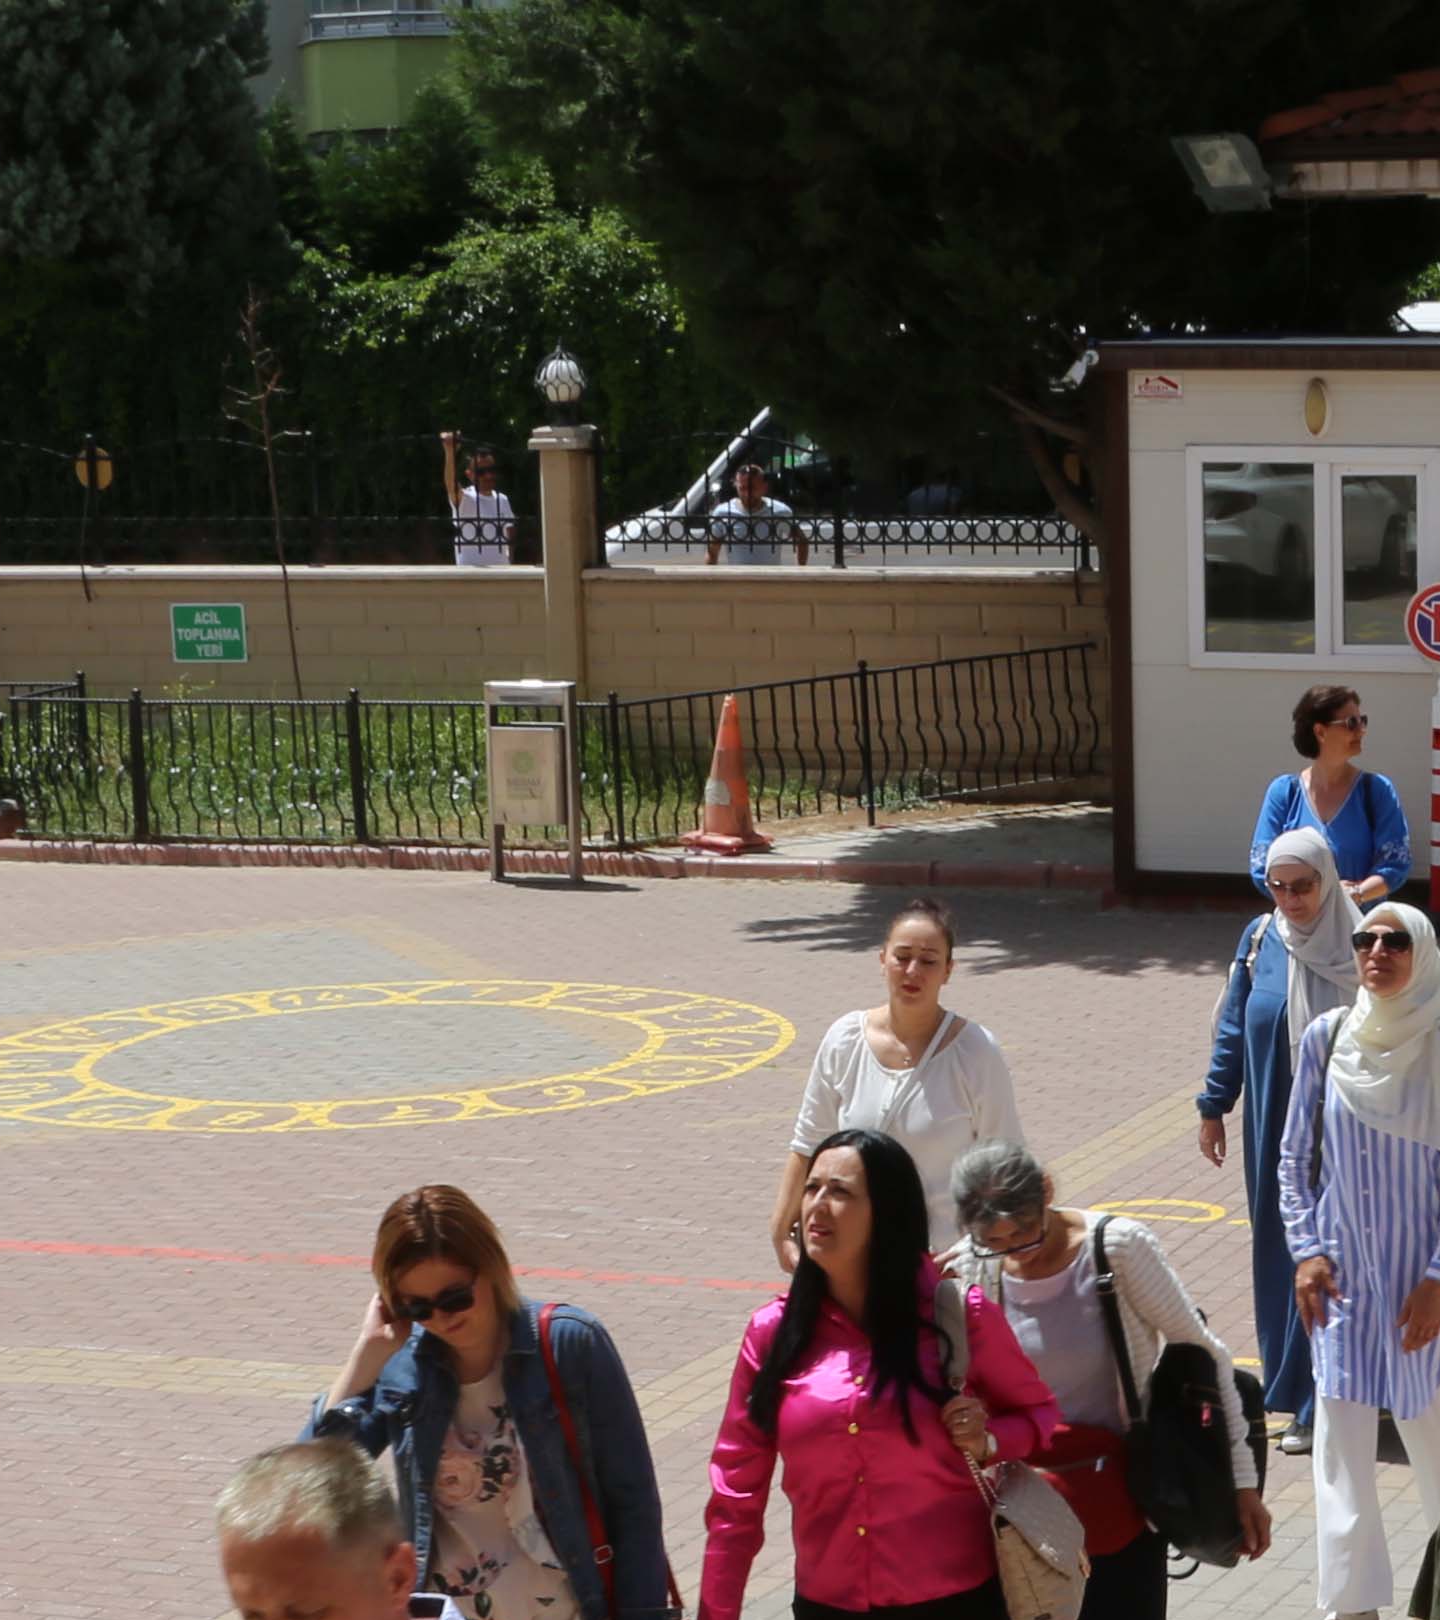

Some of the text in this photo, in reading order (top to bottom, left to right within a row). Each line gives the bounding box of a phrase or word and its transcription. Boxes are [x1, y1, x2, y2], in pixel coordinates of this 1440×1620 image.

[194, 610, 221, 625] ACİL
[177, 628, 240, 641] TOPLANMA
[196, 643, 224, 657] YERİ
